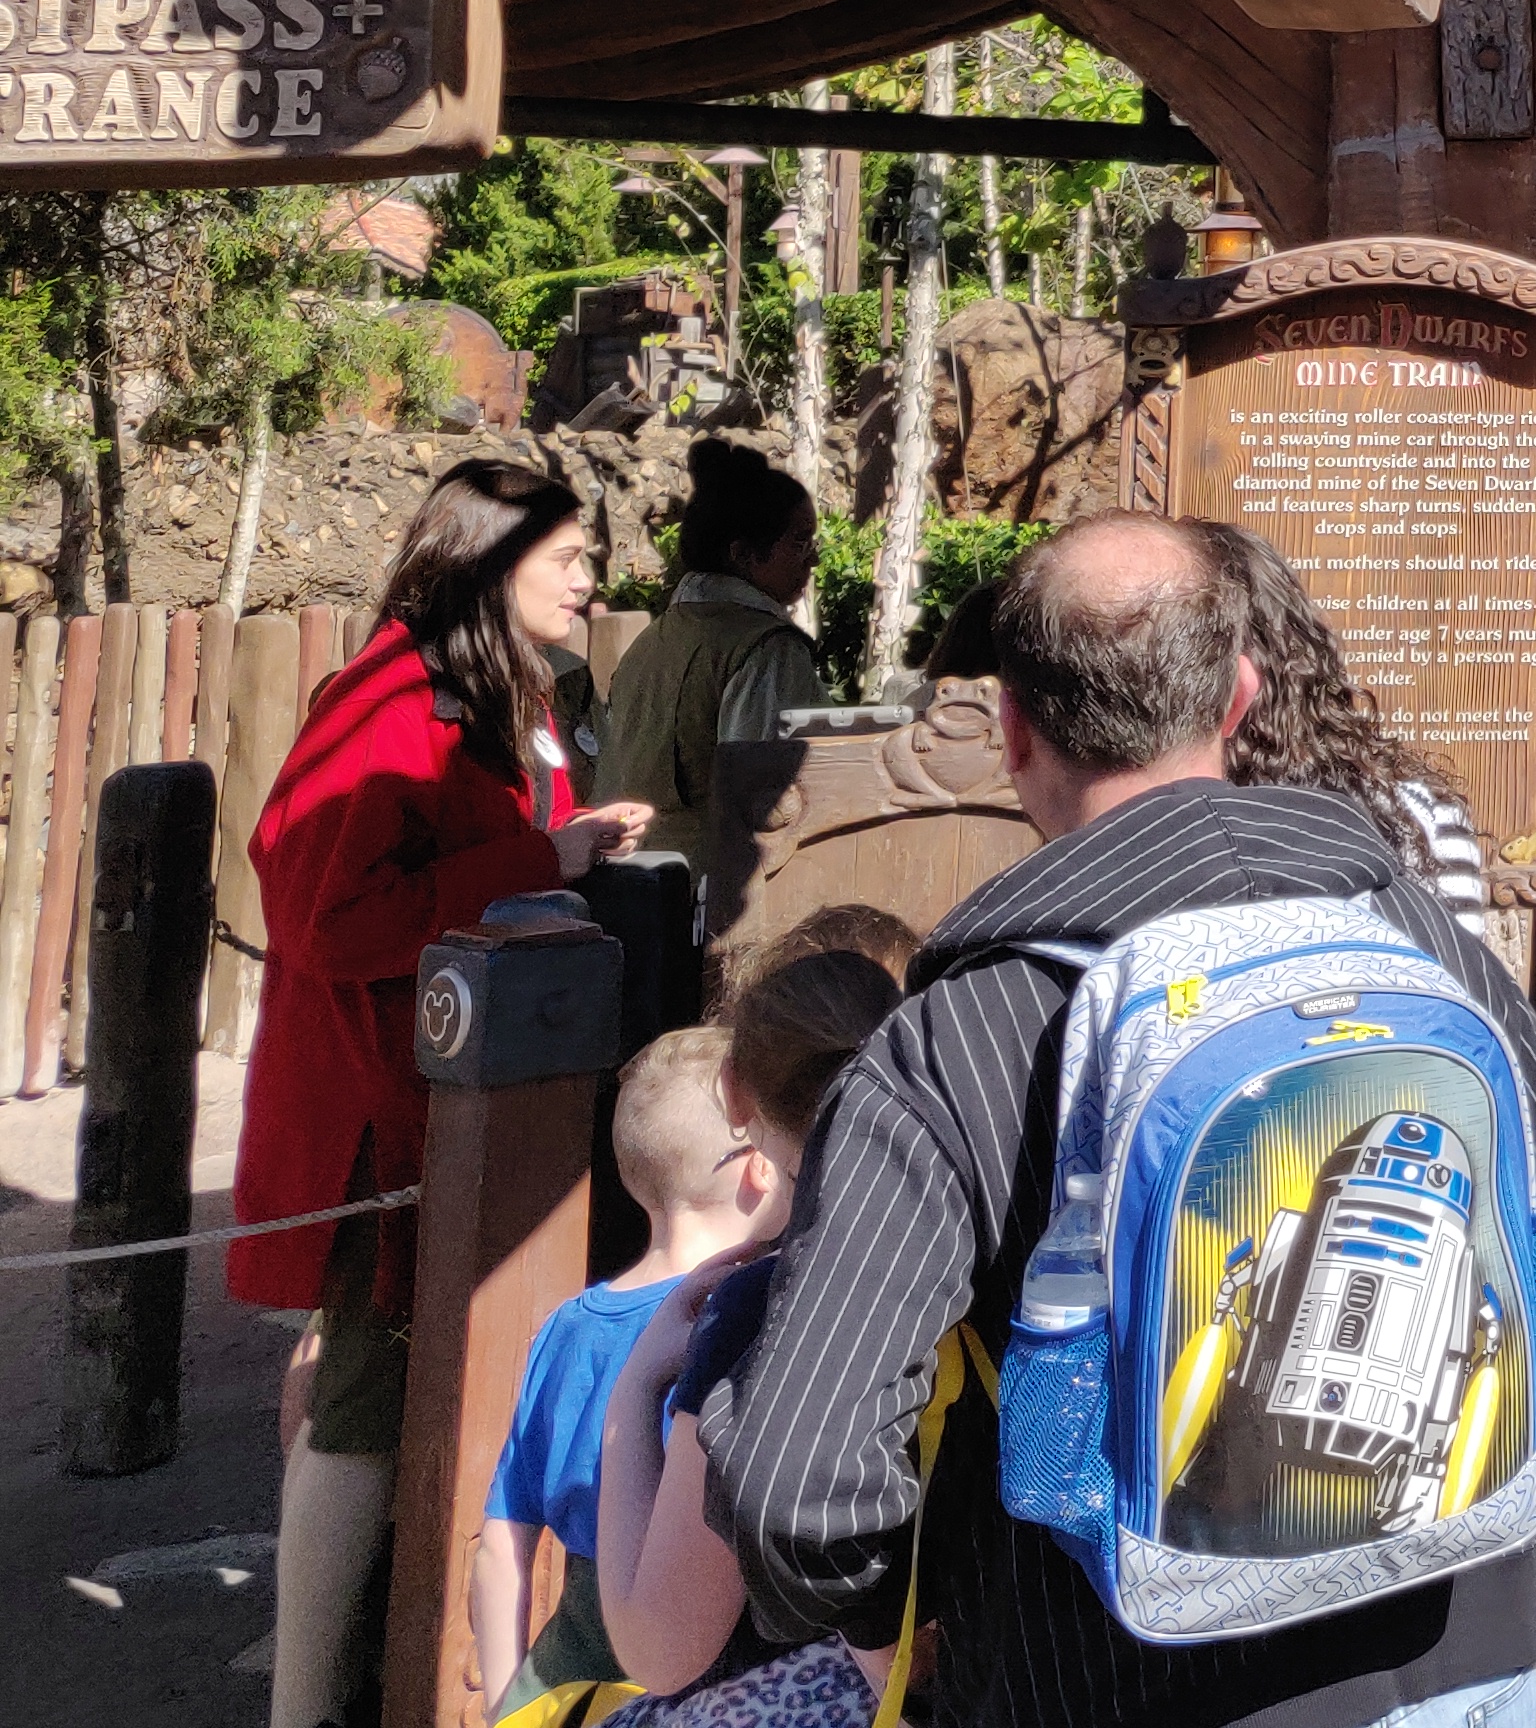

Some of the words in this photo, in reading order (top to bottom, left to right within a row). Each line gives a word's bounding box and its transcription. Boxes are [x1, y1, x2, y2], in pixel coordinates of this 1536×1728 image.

[0, 69, 324, 142] RANCE
[1255, 314, 1371, 365] SEVEN
[1376, 302, 1529, 358] DWARFS
[1296, 360, 1378, 387] MINE
[1387, 357, 1483, 388] TRAIN
[1230, 409, 1246, 424] is
[1250, 412, 1274, 424] an
[1278, 408, 1349, 427] exciting
[1354, 408, 1402, 424] roller
[1406, 411, 1516, 428] coaster-type
[1241, 431, 1257, 446] in
[1262, 435, 1274, 447] a
[1279, 432, 1352, 449] swaying
[1357, 432, 1401, 447] mine
[1406, 435, 1436, 447] car
[1440, 431, 1510, 451] through
[1252, 452, 1310, 471] rolling
[1314, 453, 1418, 472] countryside
[1422, 454, 1457, 470] and
[1462, 454, 1497, 470] into
[1502, 454, 1531, 470] the
[1232, 474, 1312, 492] diamond
[1317, 476, 1362, 491] mine
[1366, 474, 1388, 492] of
[1391, 475, 1420, 492] the
[1424, 475, 1479, 492] Seven
[1242, 496, 1278, 513] and
[1282, 497, 1355, 514] features
[1359, 497, 1410, 517] sharp
[1472, 498, 1536, 515] sudden
[1314, 518, 1366, 538] drops
[1371, 519, 1406, 536] and
[1410, 521, 1463, 538] stops.
[1326, 554, 1401, 571] mothers
[1405, 554, 1465, 571] should
[1470, 556, 1500, 571] not
[1355, 593, 1429, 611] children
[1433, 597, 1452, 611] at
[1456, 594, 1479, 611] all
[1341, 625, 1394, 641] under
[1398, 630, 1431, 645] age
[1437, 625, 1449, 642] 7
[1454, 630, 1503, 644] years
[1410, 647, 1432, 667] by
[1436, 652, 1448, 663] a
[1454, 652, 1515, 667] person
[1390, 707, 1415, 723] do
[1419, 708, 1449, 723] not
[1455, 709, 1500, 724] meet
[1504, 707, 1534, 724] the
[1422, 728, 1531, 745] requirement
[1302, 1000, 1356, 1015] TOURISTER
[1303, 994, 1355, 1010] AMERICAN
